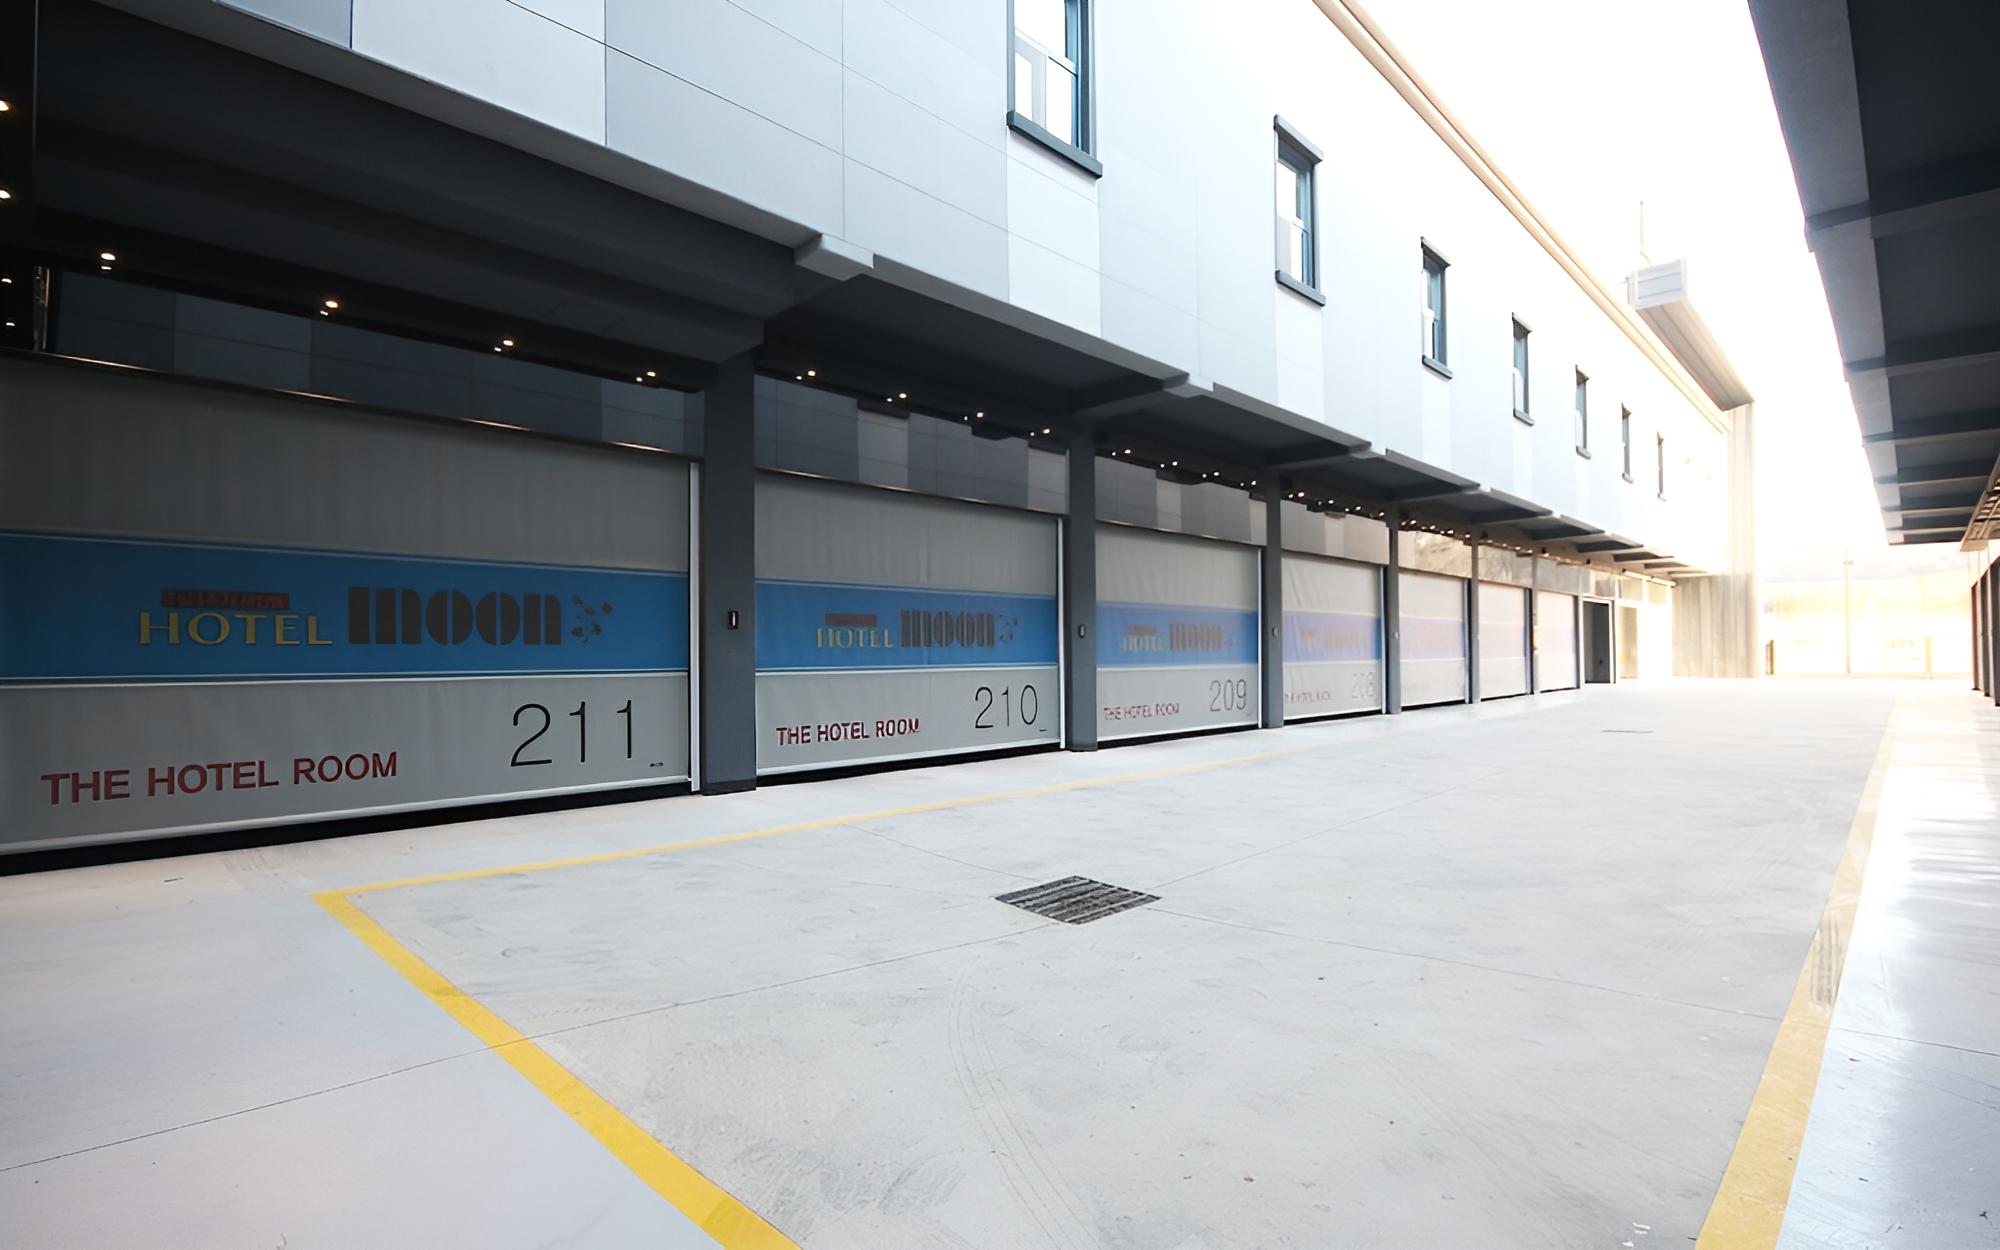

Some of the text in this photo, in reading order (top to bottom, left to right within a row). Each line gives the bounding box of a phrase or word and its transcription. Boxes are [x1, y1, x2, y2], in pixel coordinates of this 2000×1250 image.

[139, 612, 333, 645] HOTEL
[816, 627, 894, 648] HOTEL
[975, 684, 1038, 729] 210
[1209, 679, 1248, 712] 209
[511, 699, 633, 767] 211
[776, 717, 920, 746] THE HOTEL ROOM
[40, 751, 398, 805] THE HOTEL ROOM
